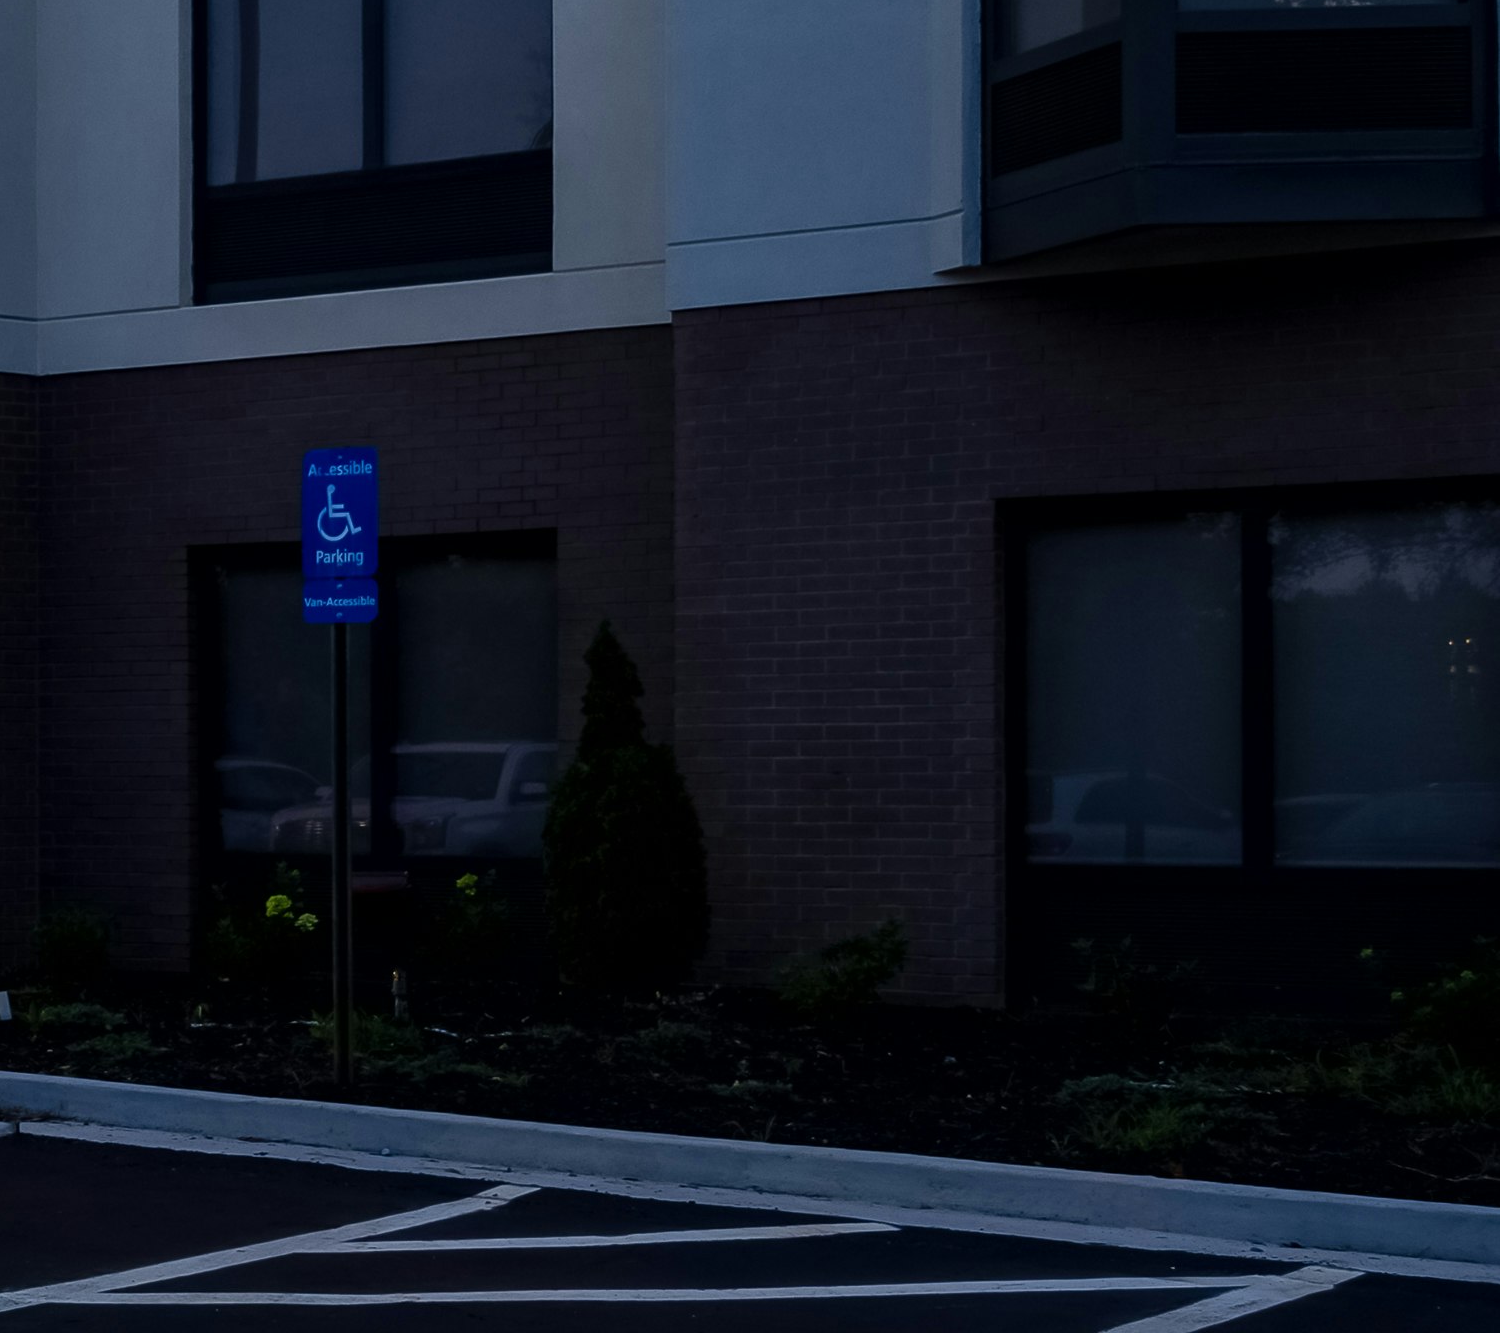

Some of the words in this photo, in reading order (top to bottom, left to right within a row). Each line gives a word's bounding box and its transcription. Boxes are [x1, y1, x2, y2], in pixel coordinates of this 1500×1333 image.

[307, 459, 373, 477] Acessible
[316, 548, 364, 566] Parking
[304, 595, 376, 607] Van-Accessible
